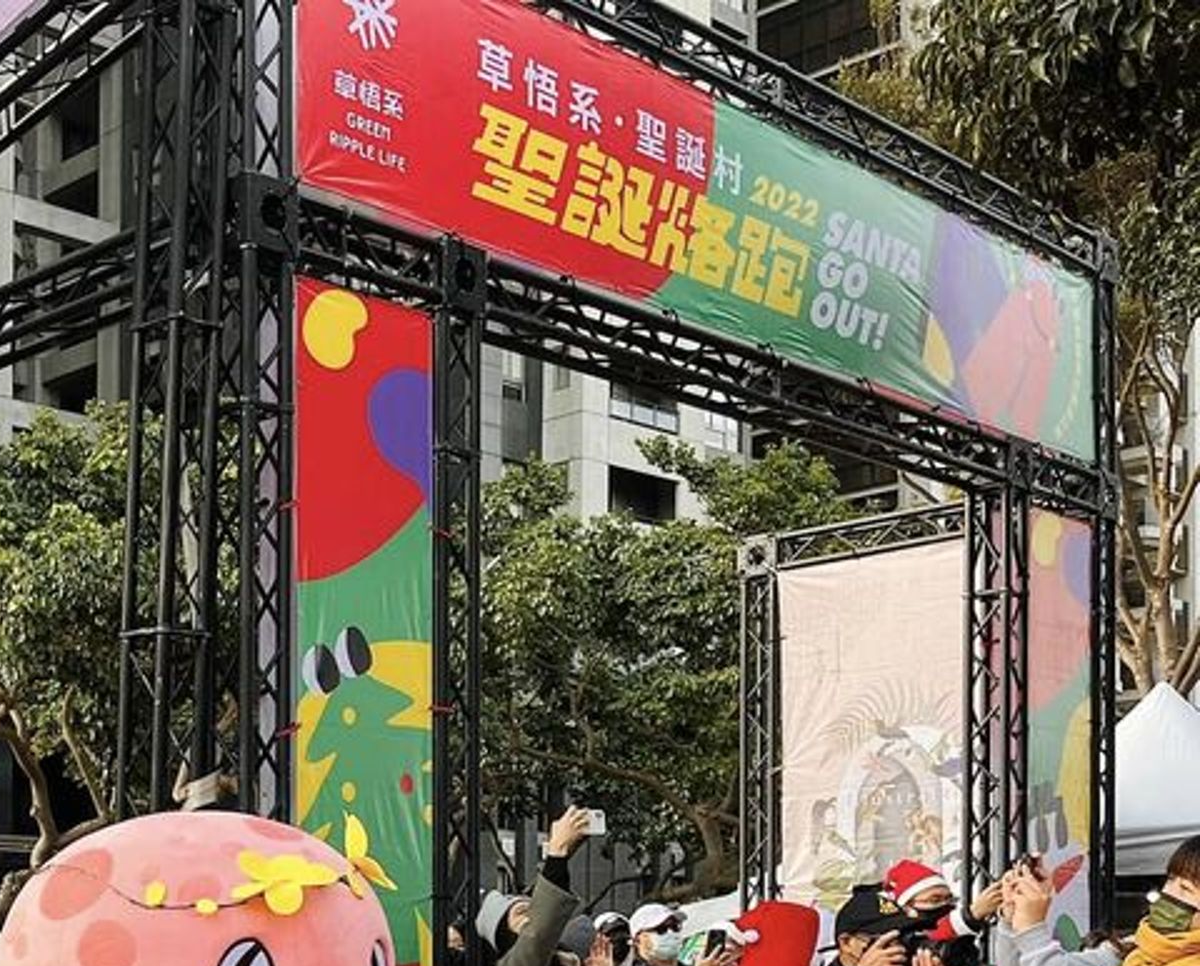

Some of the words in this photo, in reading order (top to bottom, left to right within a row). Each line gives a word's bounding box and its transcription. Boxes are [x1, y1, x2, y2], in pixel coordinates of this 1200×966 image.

[333, 69, 404, 121] 草悟系
[329, 129, 376, 161] RIPPLE
[378, 149, 407, 173] LIFE
[346, 111, 391, 142] GREEN
[750, 175, 819, 227] 2022
[821, 211, 921, 284] SANTA
[817, 251, 868, 299] GO
[810, 291, 889, 350] OUT!
